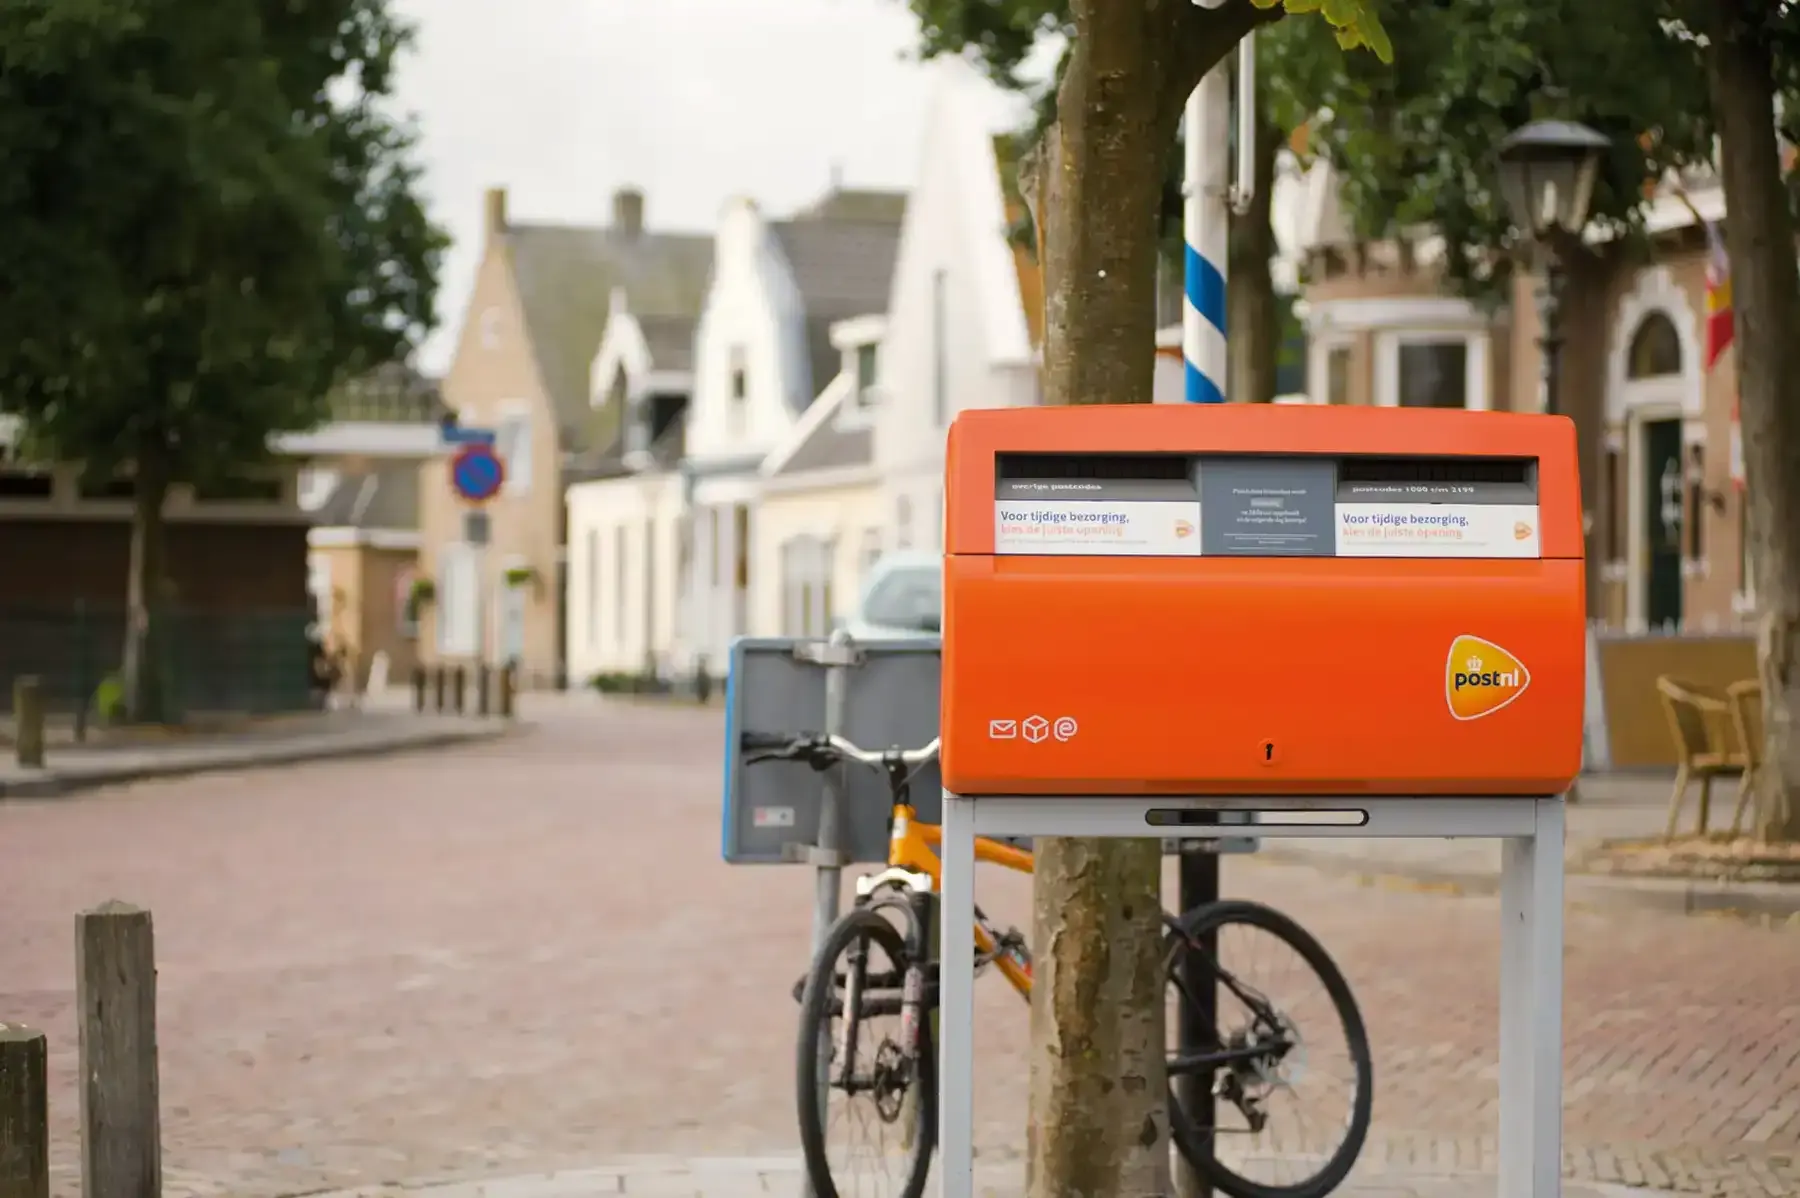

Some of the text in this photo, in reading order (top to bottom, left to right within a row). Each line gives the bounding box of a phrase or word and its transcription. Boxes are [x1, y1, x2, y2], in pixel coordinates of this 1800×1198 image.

[1000, 510, 1129, 524] Voor tijdige bezorging,
[1343, 513, 1469, 526] Voor tijdige bezorging,
[1027, 524, 1040, 534] de
[1042, 525, 1074, 537] juiste
[1076, 525, 1123, 537] opening
[1367, 526, 1381, 537] de
[1384, 526, 1413, 538] juiste
[1417, 527, 1463, 539] opening
[1455, 668, 1519, 692] postnl
